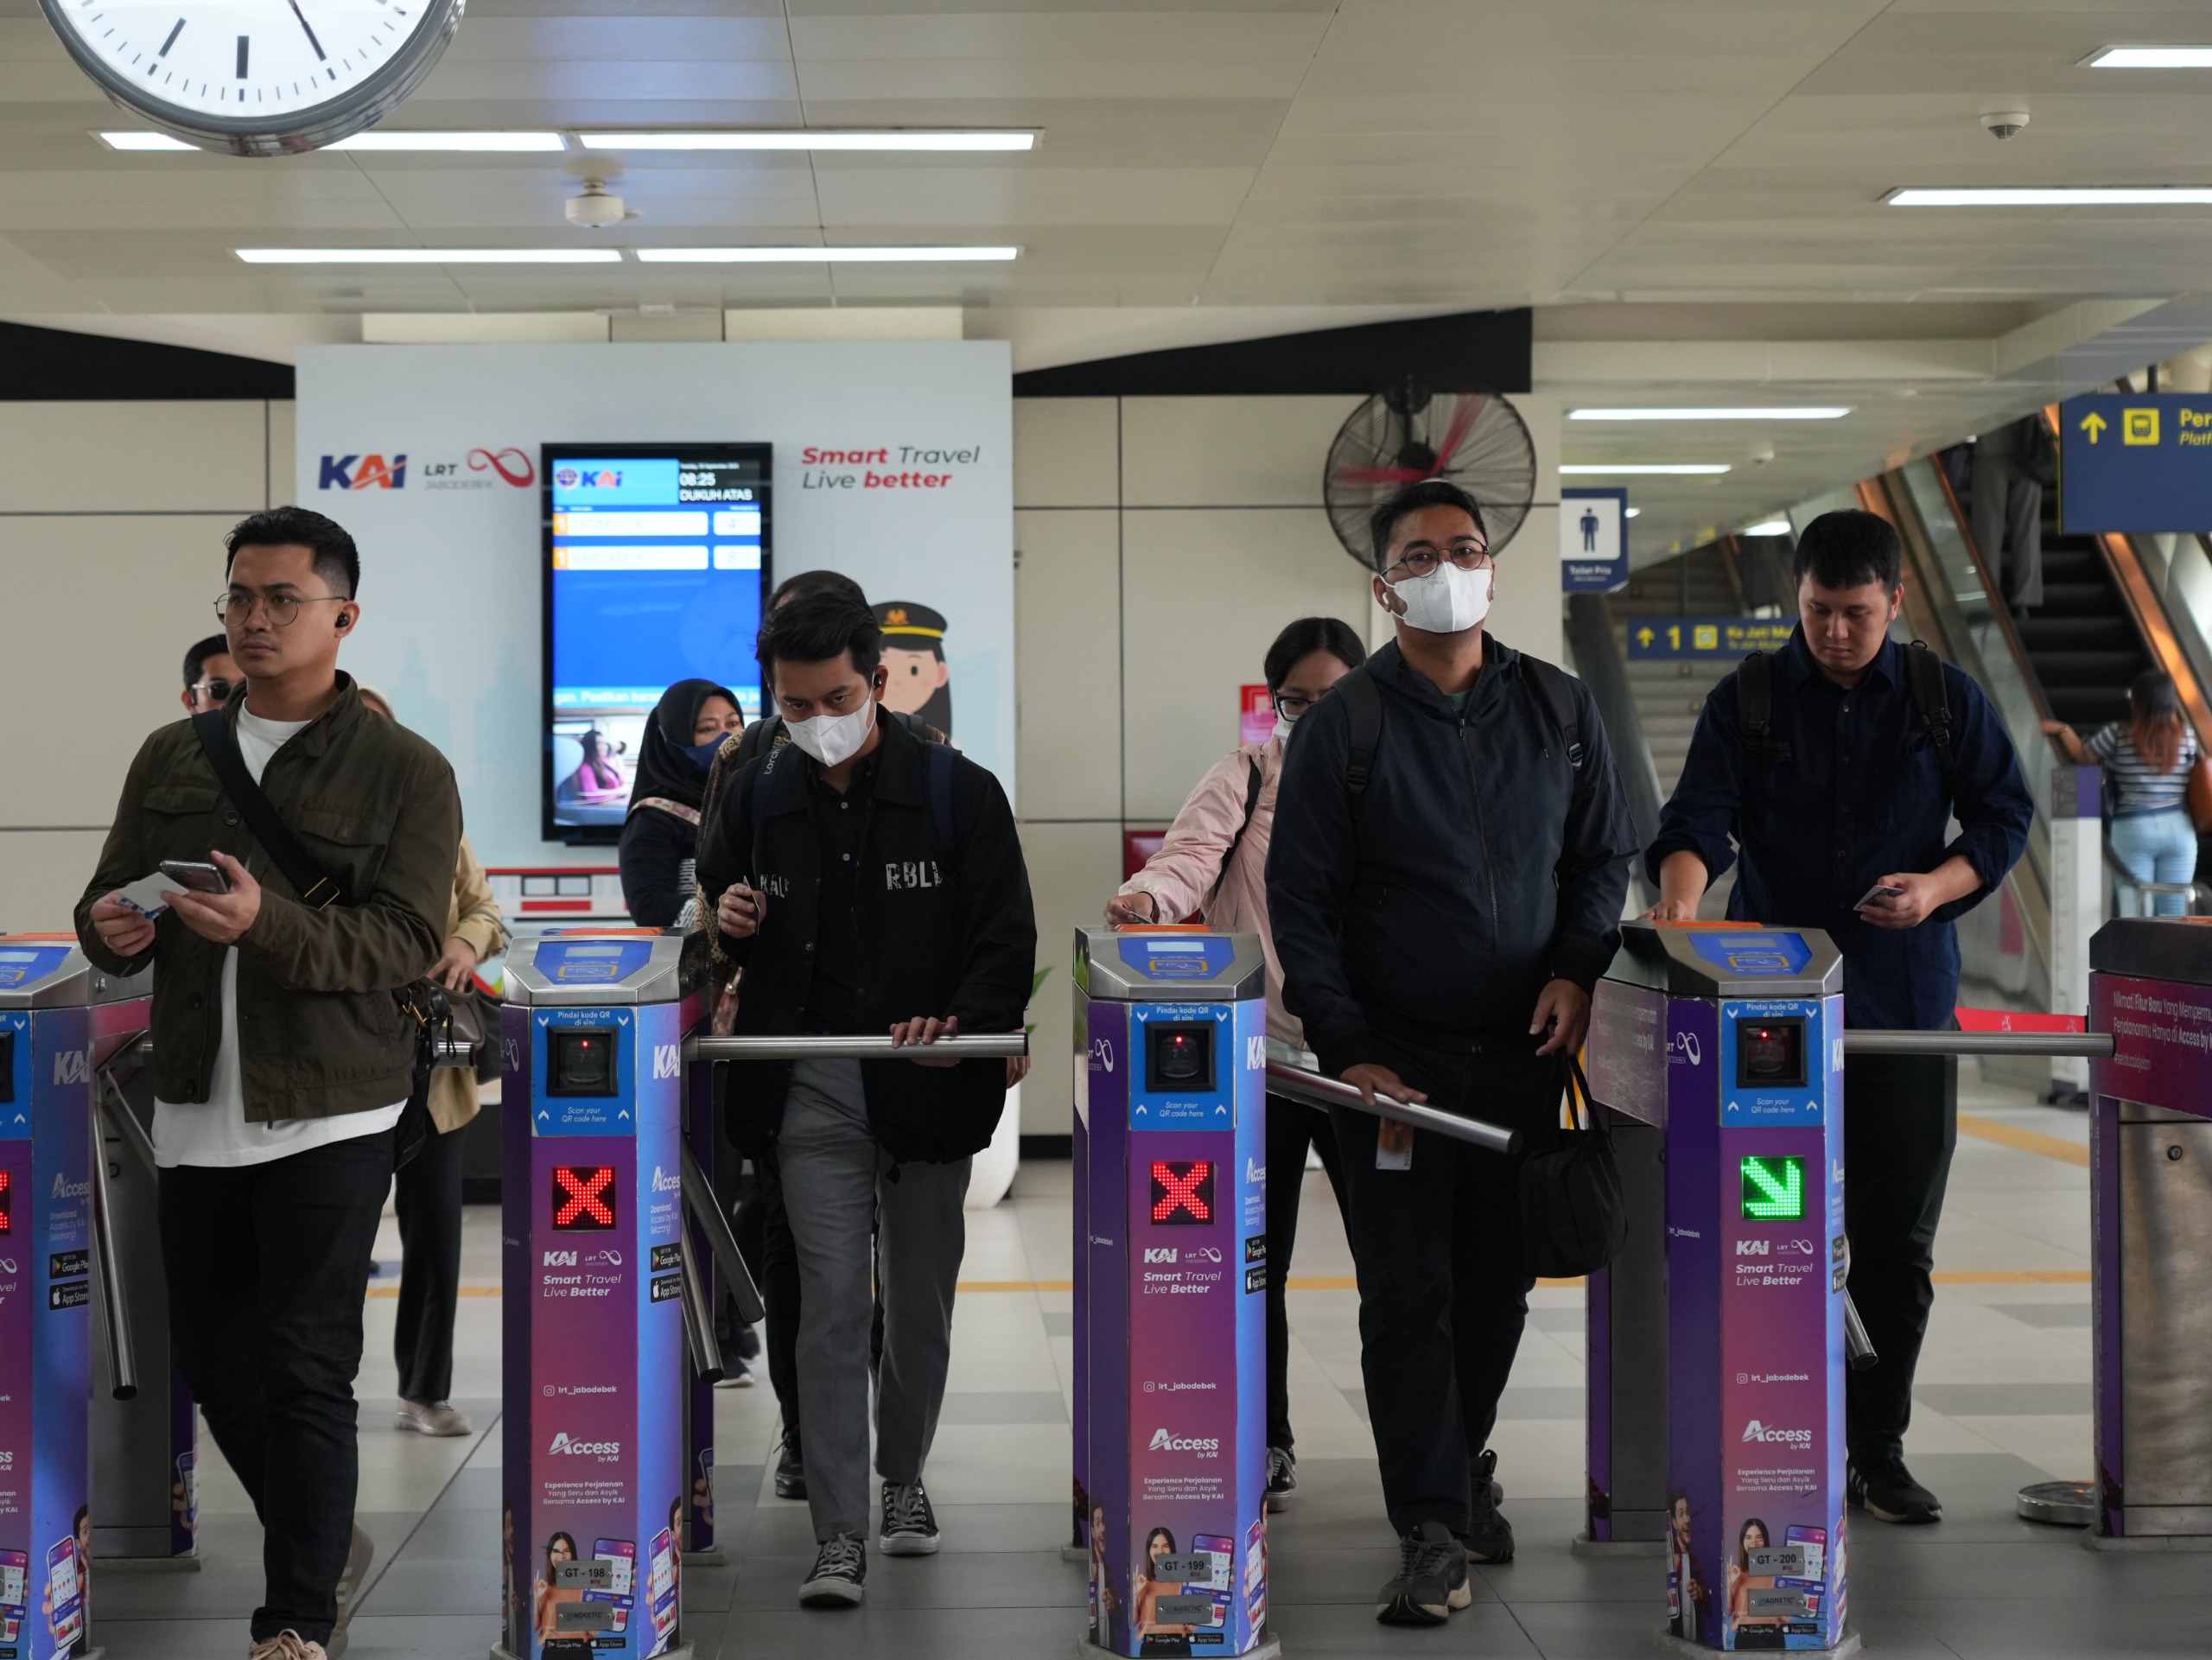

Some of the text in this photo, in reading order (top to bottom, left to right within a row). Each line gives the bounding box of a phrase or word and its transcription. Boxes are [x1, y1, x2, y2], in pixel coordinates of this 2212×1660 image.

[2180, 409, 2212, 427] Per
[802, 446, 980, 465] Smart Travel
[318, 455, 408, 489] KAI
[425, 465, 458, 475] LRT
[679, 472, 715, 486] 08:25
[803, 471, 952, 489] Live better
[425, 480, 494, 490] JABODEBEK
[679, 489, 753, 501] DUKUH ATAS
[1668, 626, 1680, 650] 1
[2113, 992, 2134, 1009] Nikmati
[2135, 993, 2147, 1012] Fitur
[2149, 996, 2162, 1013] Baru
[2162, 997, 2177, 1021] Yang
[2178, 1027, 2200, 1047] Access
[2201, 1030, 2209, 1054] by
[1736, 1240, 1770, 1256] KAI
[543, 1251, 577, 1266] KAI
[1144, 1249, 1178, 1263] KAI
[1736, 1263, 1813, 1274] Smart Travel
[543, 1274, 622, 1285] Smart Travel
[1144, 1271, 1221, 1282] Smart Travel
[1737, 1276, 1802, 1286] Live Better
[543, 1287, 610, 1297] Live Better
[1144, 1284, 1210, 1294] Live Better
[1751, 1373, 1809, 1383] lrt_jabodebek
[558, 1385, 617, 1395] lrt_jabodebek
[1159, 1383, 1217, 1391] lrt_jabodebek
[1742, 1421, 1811, 1442] Access
[549, 1433, 620, 1455] Access
[1148, 1428, 1218, 1451] Access
[1793, 1476, 1810, 1485] Asyik
[1199, 1485, 1217, 1493] Asyik
[1758, 1555, 1770, 1564] GT
[1780, 1555, 1796, 1563] 200
[1165, 1561, 1179, 1571] GT
[1187, 1561, 1205, 1570] 199
[565, 1568, 579, 1577] GT
[588, 1568, 605, 1577] 198
